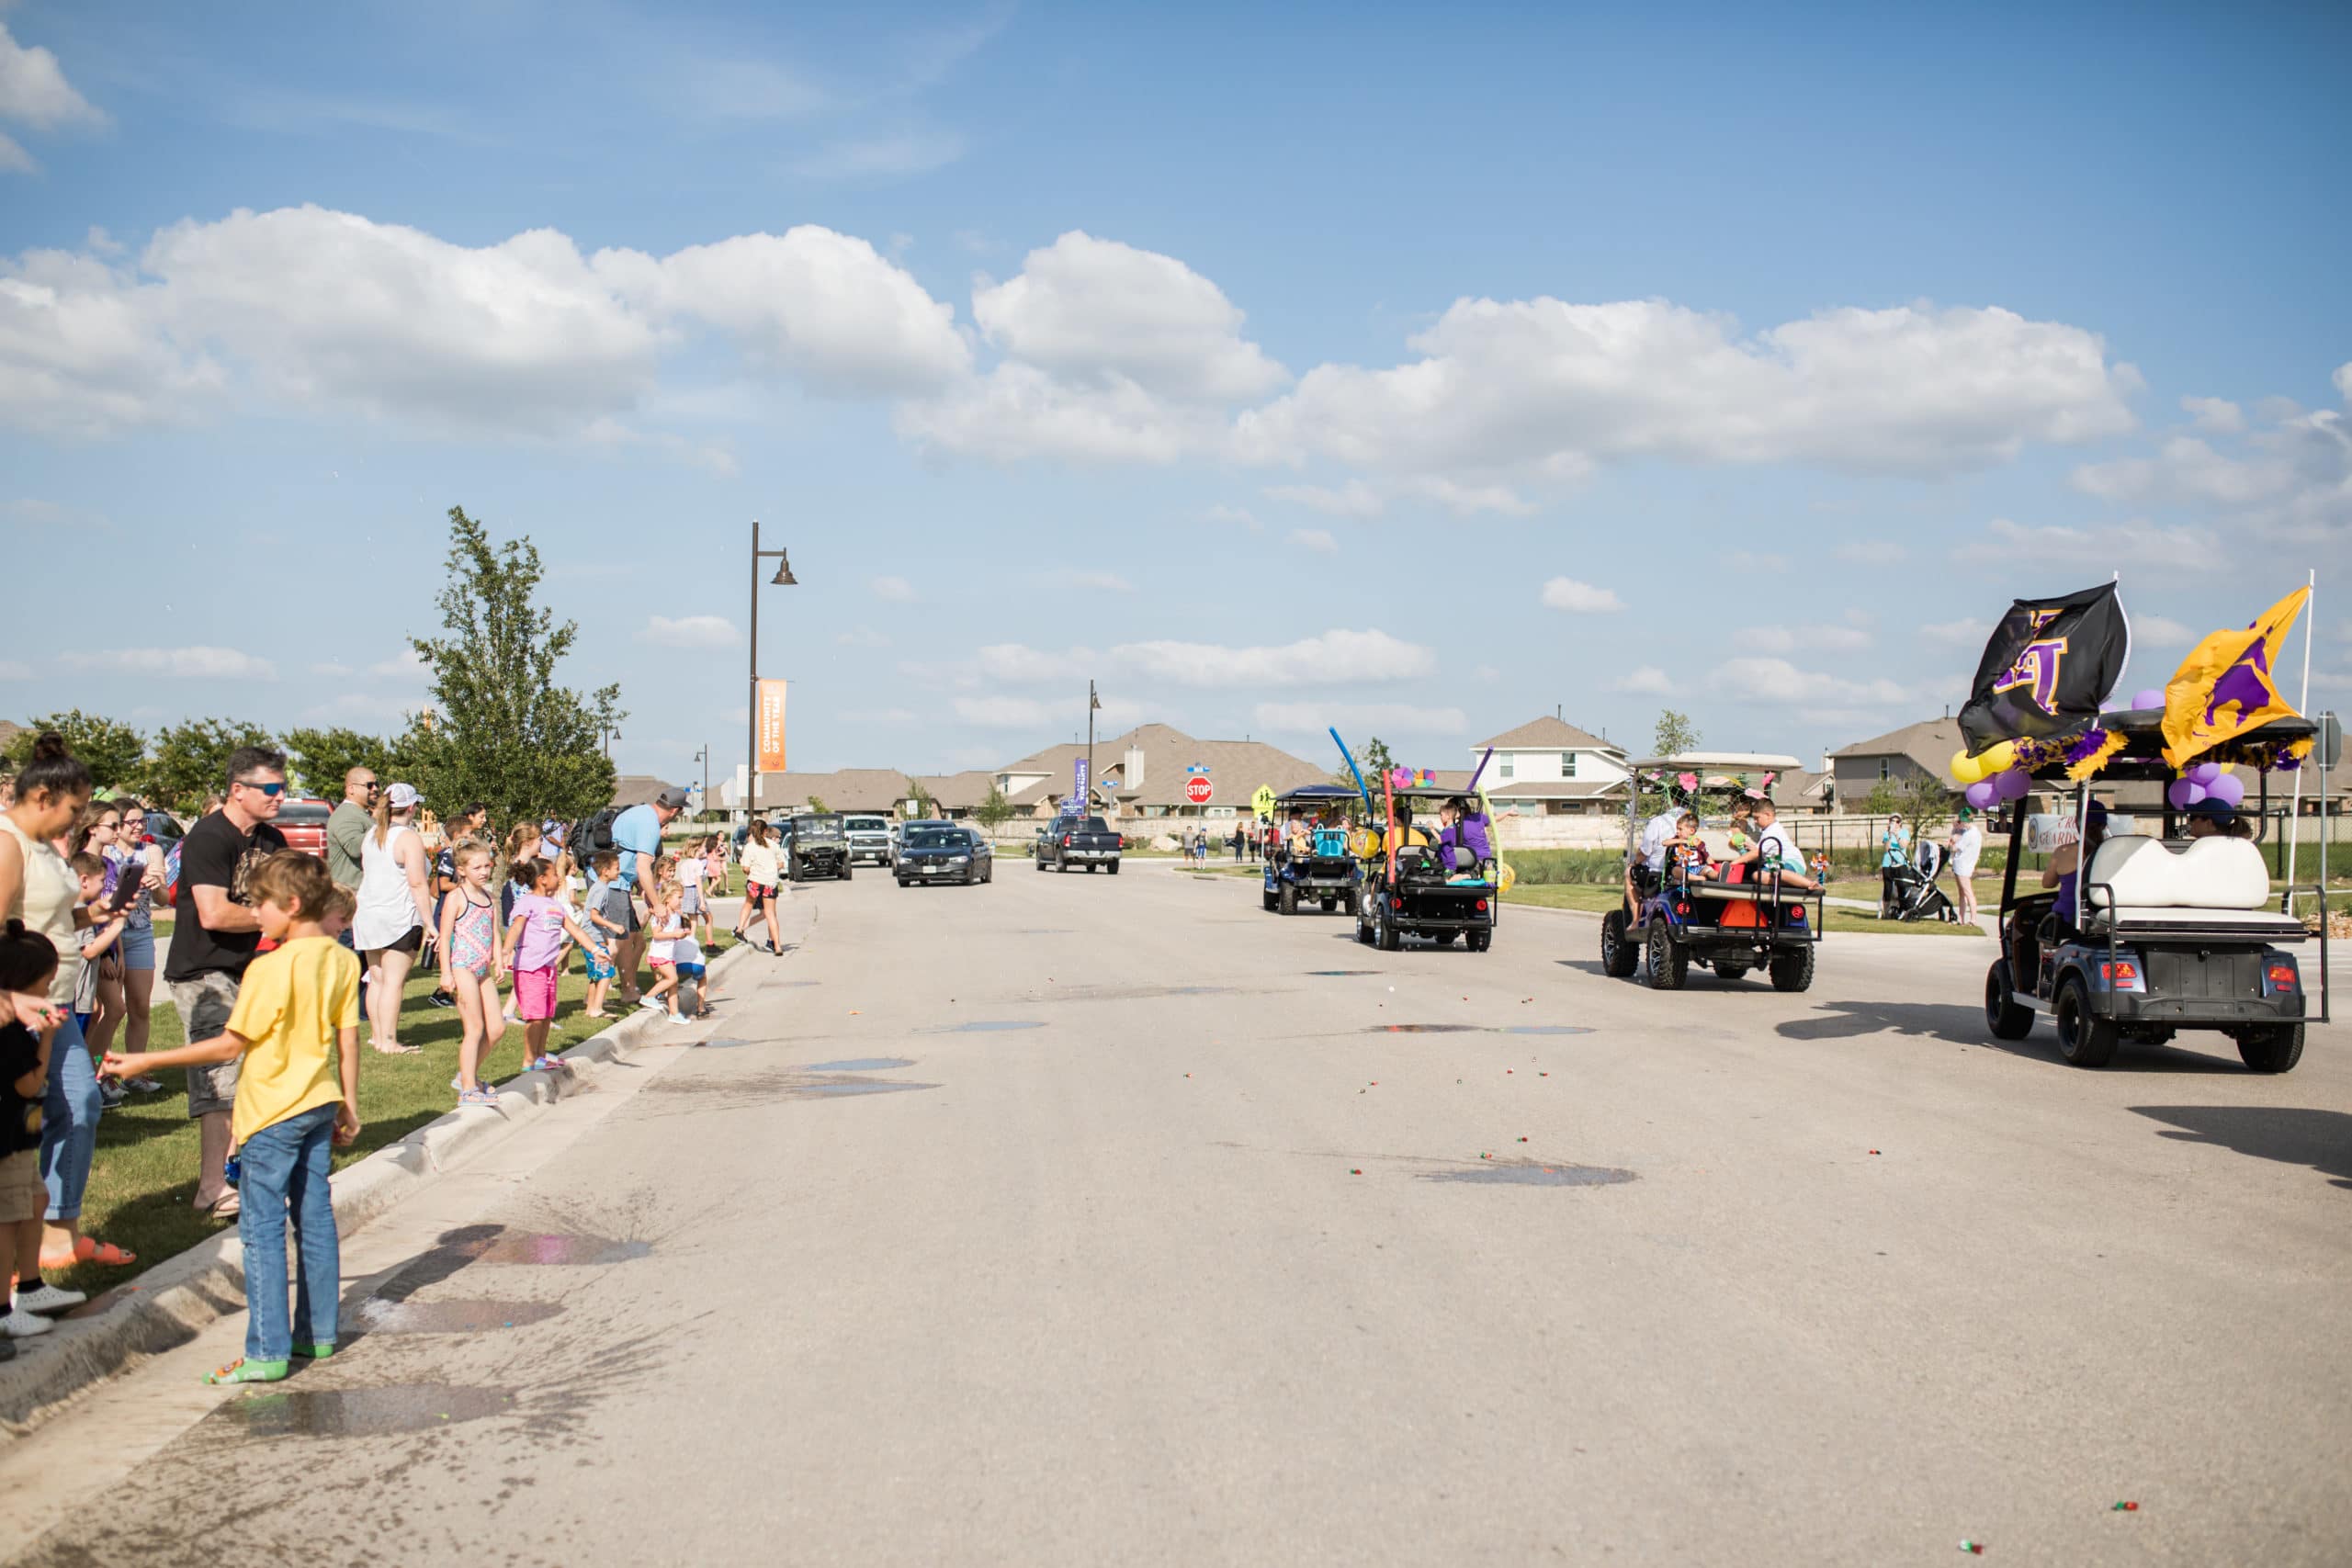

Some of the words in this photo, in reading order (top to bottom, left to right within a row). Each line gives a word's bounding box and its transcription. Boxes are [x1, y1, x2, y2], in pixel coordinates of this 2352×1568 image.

[772, 696, 780, 720] YEAR
[772, 721, 780, 738] THE
[772, 740, 780, 753] OF
[1187, 784, 1211, 795] STOP
